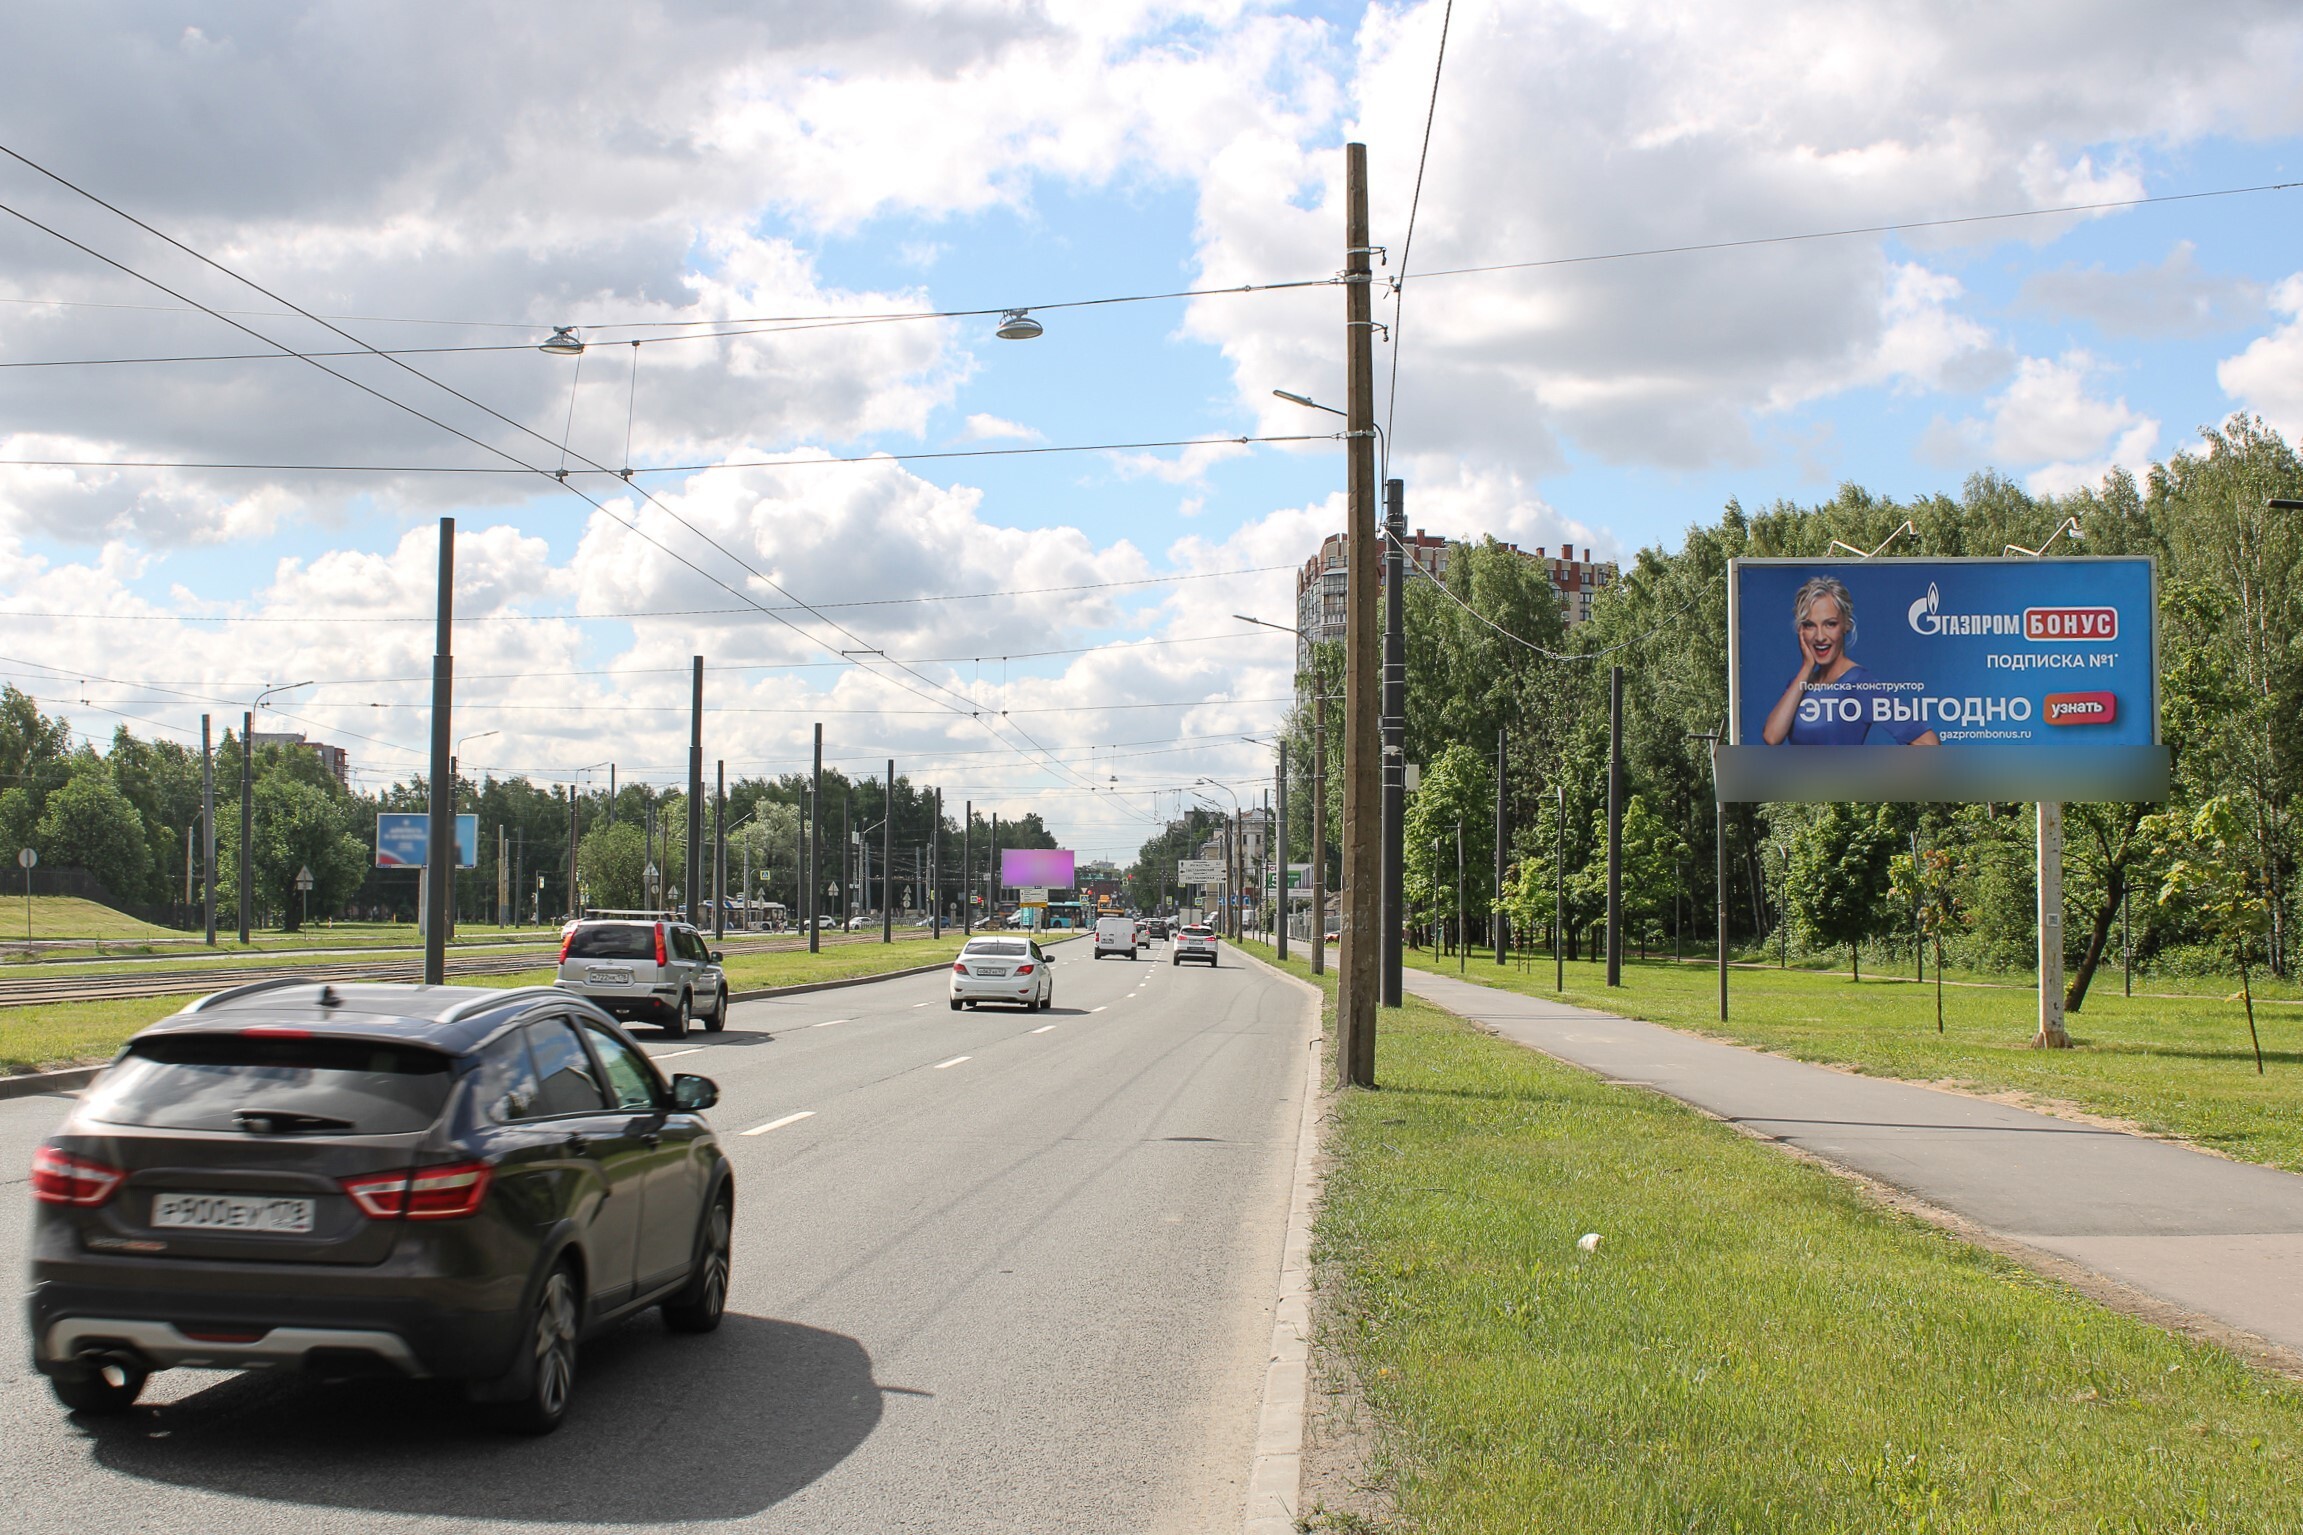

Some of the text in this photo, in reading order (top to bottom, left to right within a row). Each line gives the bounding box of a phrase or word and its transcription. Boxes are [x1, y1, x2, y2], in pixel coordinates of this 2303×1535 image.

[1942, 614, 2111, 635] ГАЗПРОМ БОНУС
[1987, 654, 2085, 671] ПОДПИСКА
[1799, 681, 1925, 692] Подписка-конструктор
[1799, 697, 2032, 726] ЭТО ВЫГОДНО
[2051, 700, 2104, 718] узнать
[1939, 729, 2032, 742] gazprombonus.ru
